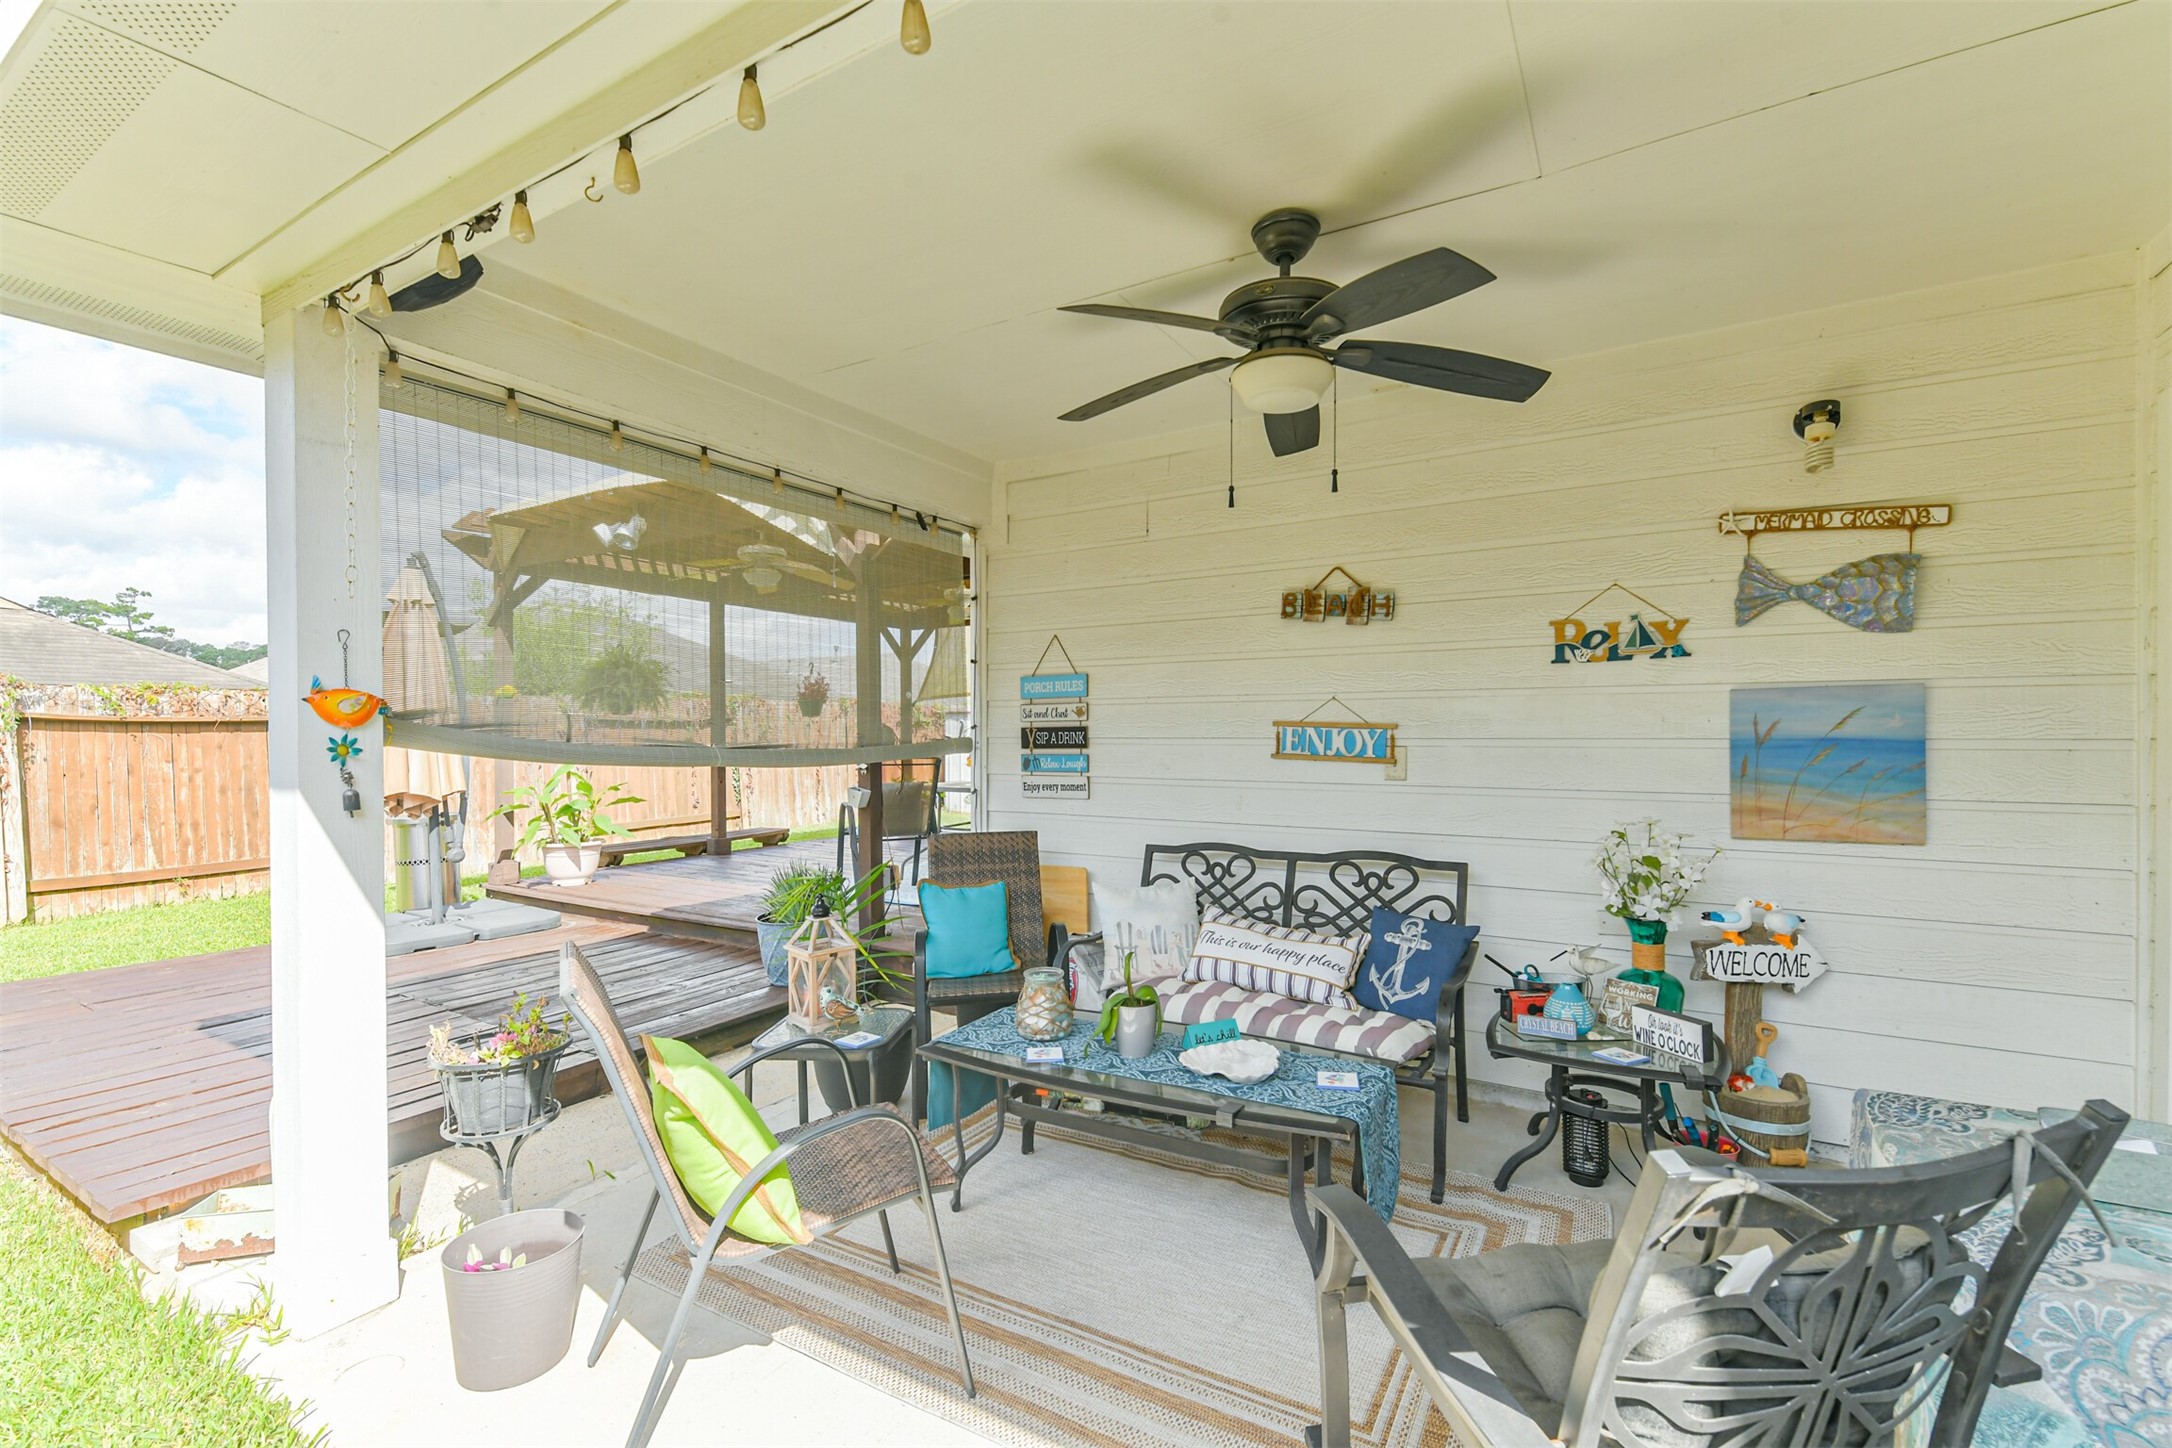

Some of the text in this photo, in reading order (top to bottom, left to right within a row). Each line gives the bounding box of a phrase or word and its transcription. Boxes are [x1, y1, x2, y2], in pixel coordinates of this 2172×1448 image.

[1281, 588, 1391, 617] BEACH
[1024, 680, 1084, 693] PORCH RULES
[1022, 707, 1069, 719] Sit and Chat
[1035, 731, 1085, 744] SIP A DRINK
[1283, 726, 1384, 758] ENJOY
[1023, 781, 1087, 793] Enjoy every moment
[1200, 929, 1346, 974] This is our happy place
[1709, 949, 1811, 978] WELCOME
[1608, 985, 1654, 1001] WORKING
[1215, 1027, 1237, 1042] chill
[1519, 1016, 1574, 1036] CRYSTAL BEACH
[1634, 1024, 1657, 1046] WINE
